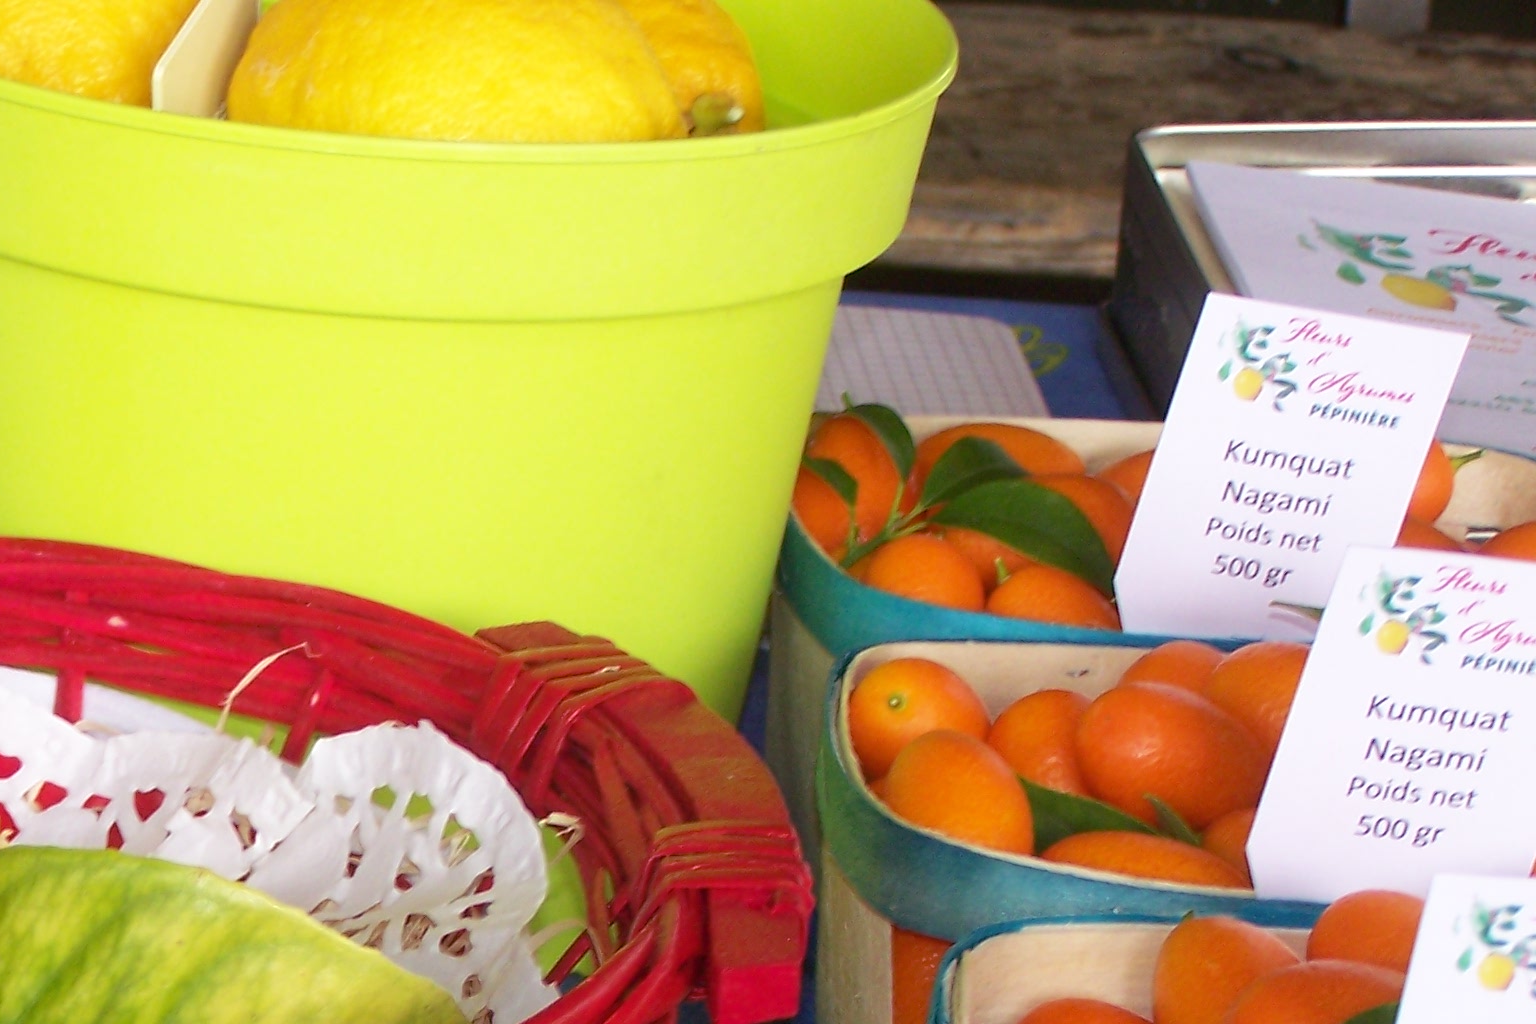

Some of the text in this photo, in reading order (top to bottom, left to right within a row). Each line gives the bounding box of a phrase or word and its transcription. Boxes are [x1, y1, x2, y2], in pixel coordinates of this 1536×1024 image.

[1283, 317, 1353, 347] Fleurs
[1307, 371, 1416, 403] Agrumes
[1309, 403, 1401, 428] PÉPINIÈRE
[1223, 439, 1355, 479] Kumquat
[1221, 480, 1333, 516] Nagami
[1205, 517, 1323, 552] Poids net
[1211, 554, 1294, 588] 500 gr
[1430, 566, 1508, 594] Fleurs
[1366, 695, 1514, 732] Kumquat
[1364, 737, 1488, 772] Nagami
[1346, 776, 1479, 809] Poids net
[1354, 815, 1446, 848] 500 gr
